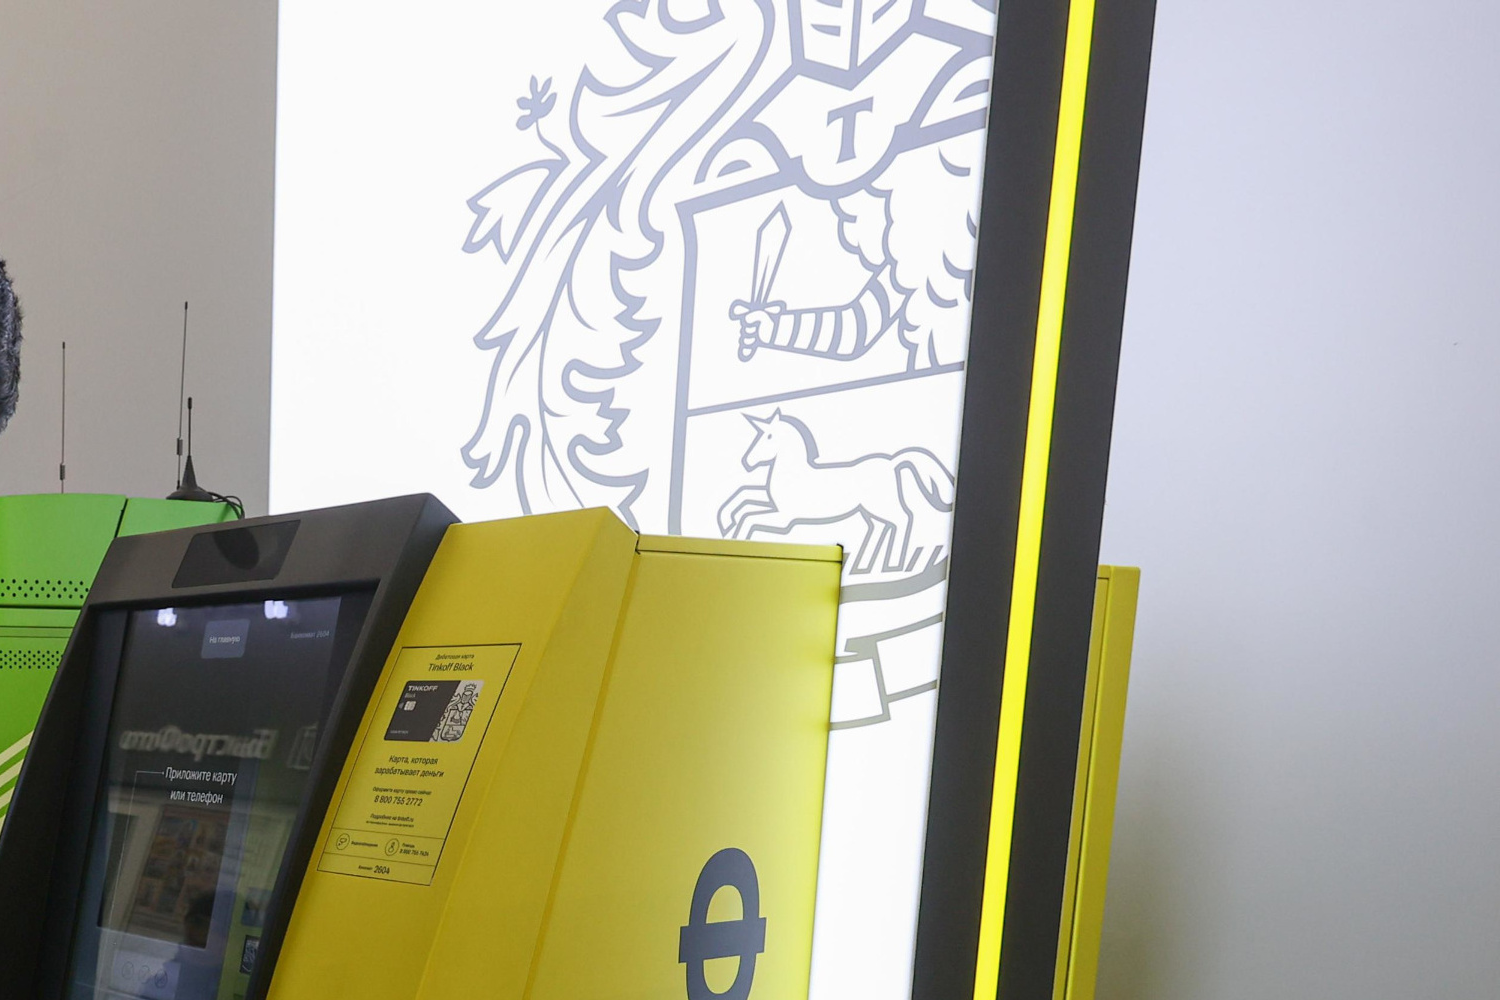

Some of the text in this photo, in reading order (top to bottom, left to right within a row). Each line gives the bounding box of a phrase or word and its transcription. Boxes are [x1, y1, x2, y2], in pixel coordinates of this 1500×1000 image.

[428, 661, 474, 672] Tinkoff Black
[388, 755, 438, 766] Карта, которая
[165, 766, 238, 786] Приложите карту
[374, 766, 445, 778] зарабатывает деньги
[170, 790, 224, 806] или телефон
[380, 795, 393, 804] 800
[393, 797, 406, 805] 755
[406, 797, 423, 806] 2772
